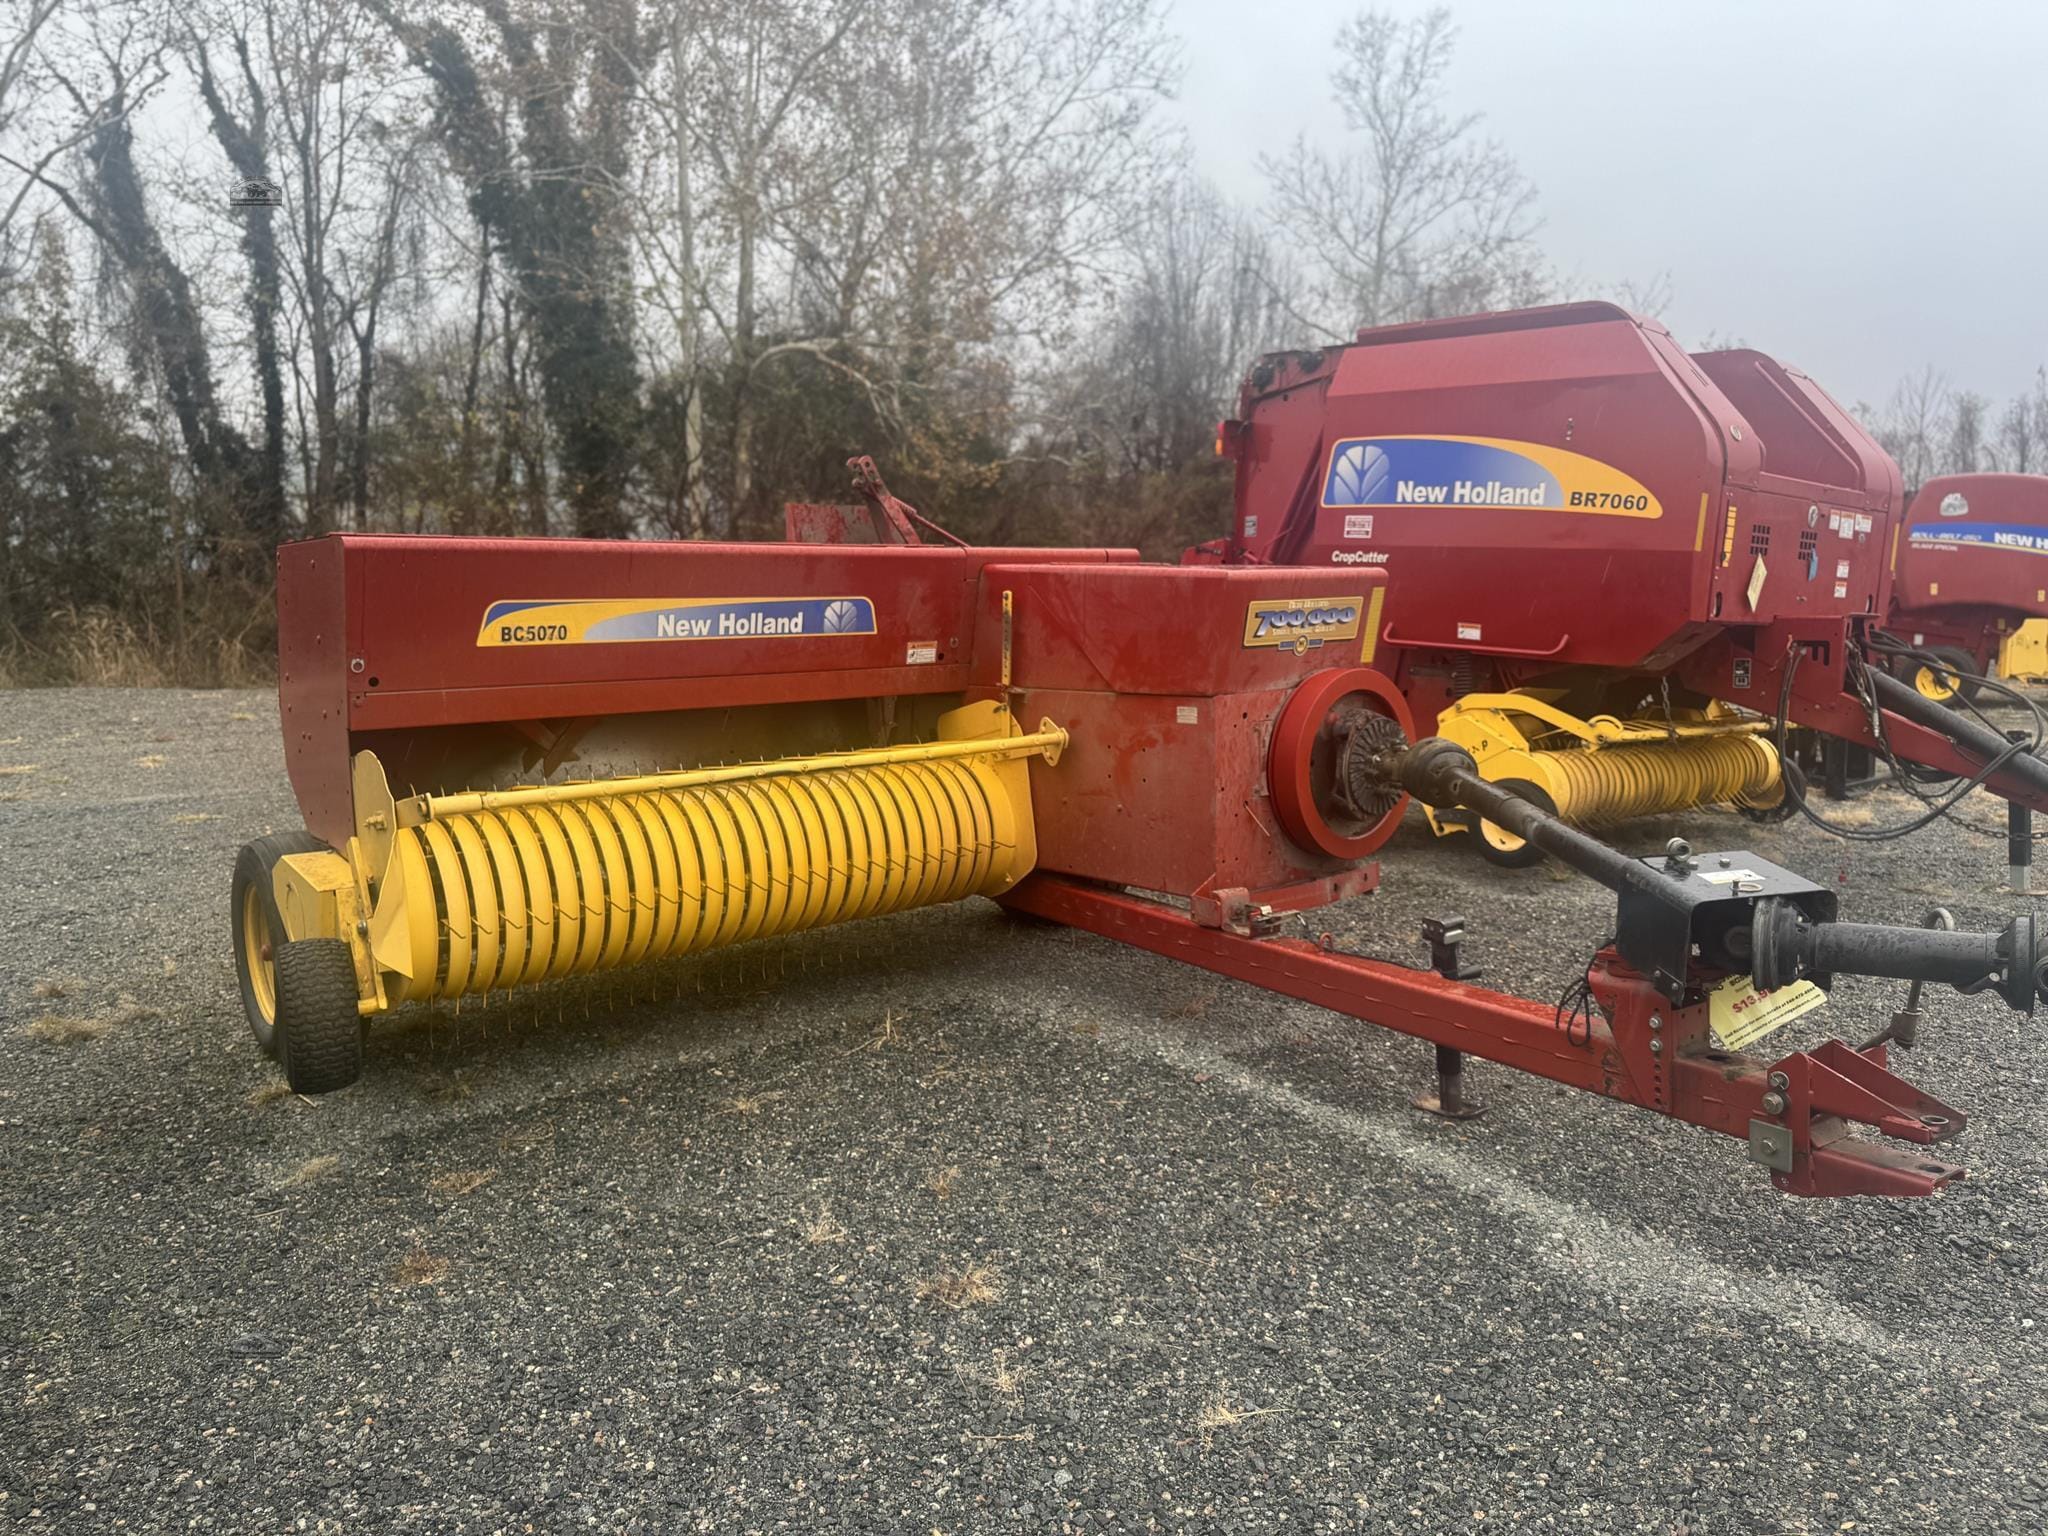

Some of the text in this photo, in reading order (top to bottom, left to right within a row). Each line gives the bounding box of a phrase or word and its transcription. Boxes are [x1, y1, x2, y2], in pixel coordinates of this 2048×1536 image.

[1396, 480, 1649, 512] New Holland BR7060
[1994, 532, 2032, 548] NEW
[1331, 550, 1389, 565] CropCutter
[500, 611, 803, 642] BC5070 New Holland
[1253, 606, 1356, 638] 700,000
